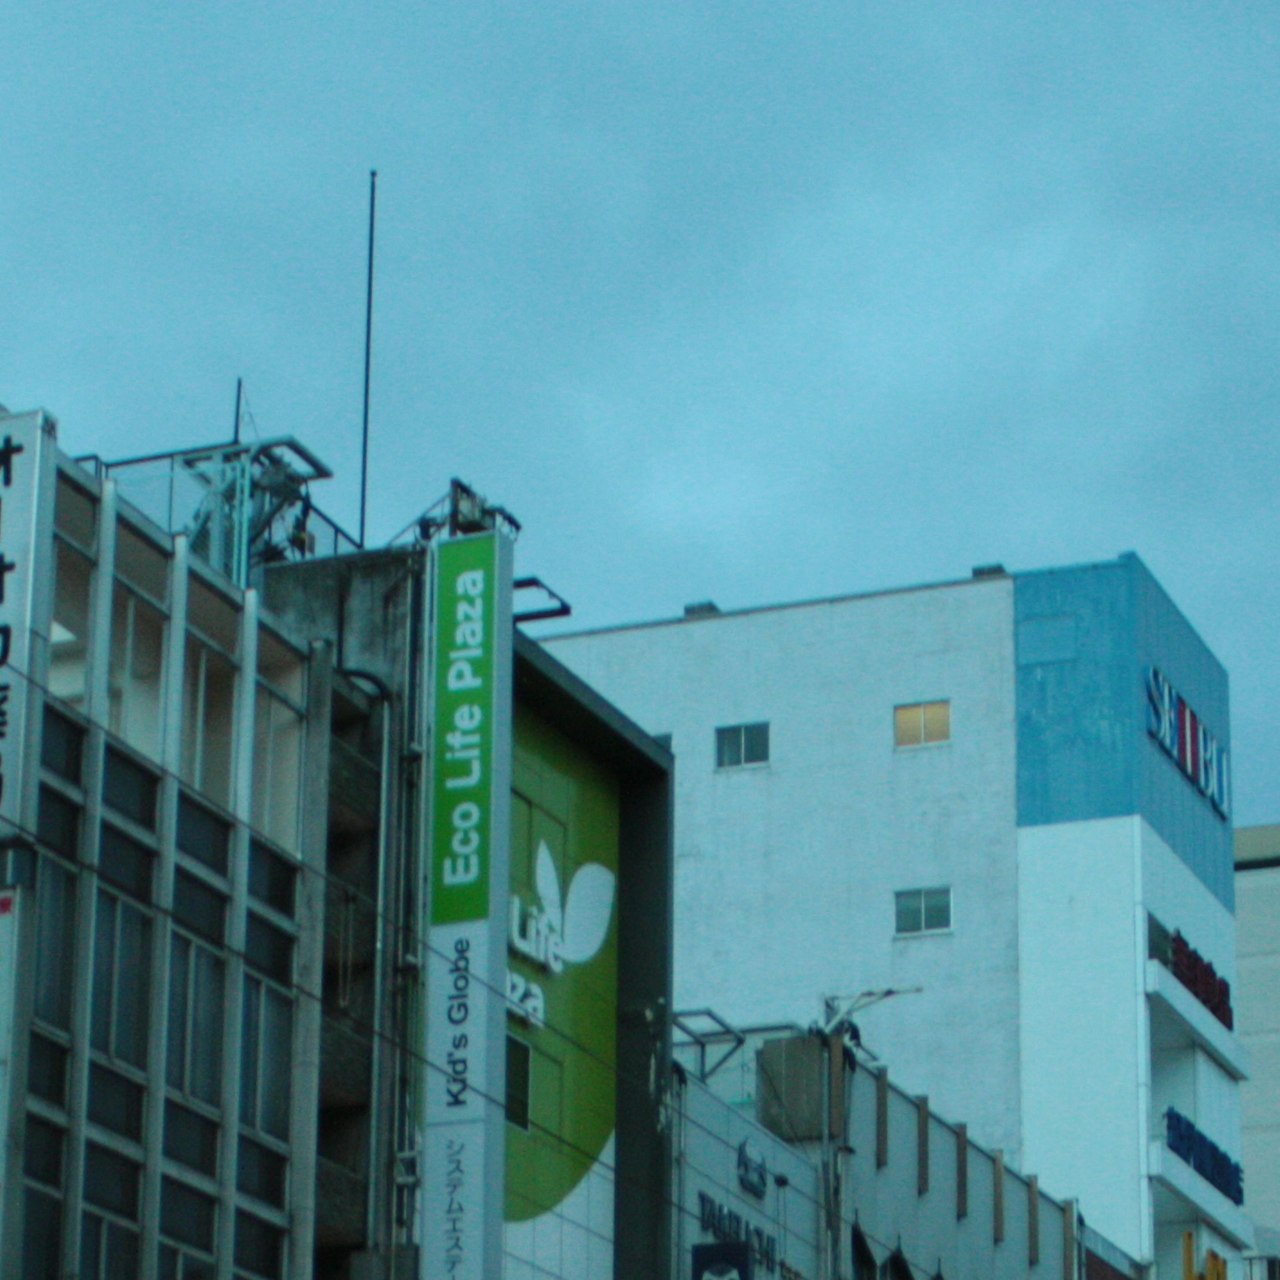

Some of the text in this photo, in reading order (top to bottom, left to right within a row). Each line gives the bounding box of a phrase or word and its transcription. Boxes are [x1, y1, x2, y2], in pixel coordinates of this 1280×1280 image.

[443, 569, 486, 888] Eco Life Plaza
[446, 938, 472, 1108] Kid's Globe
